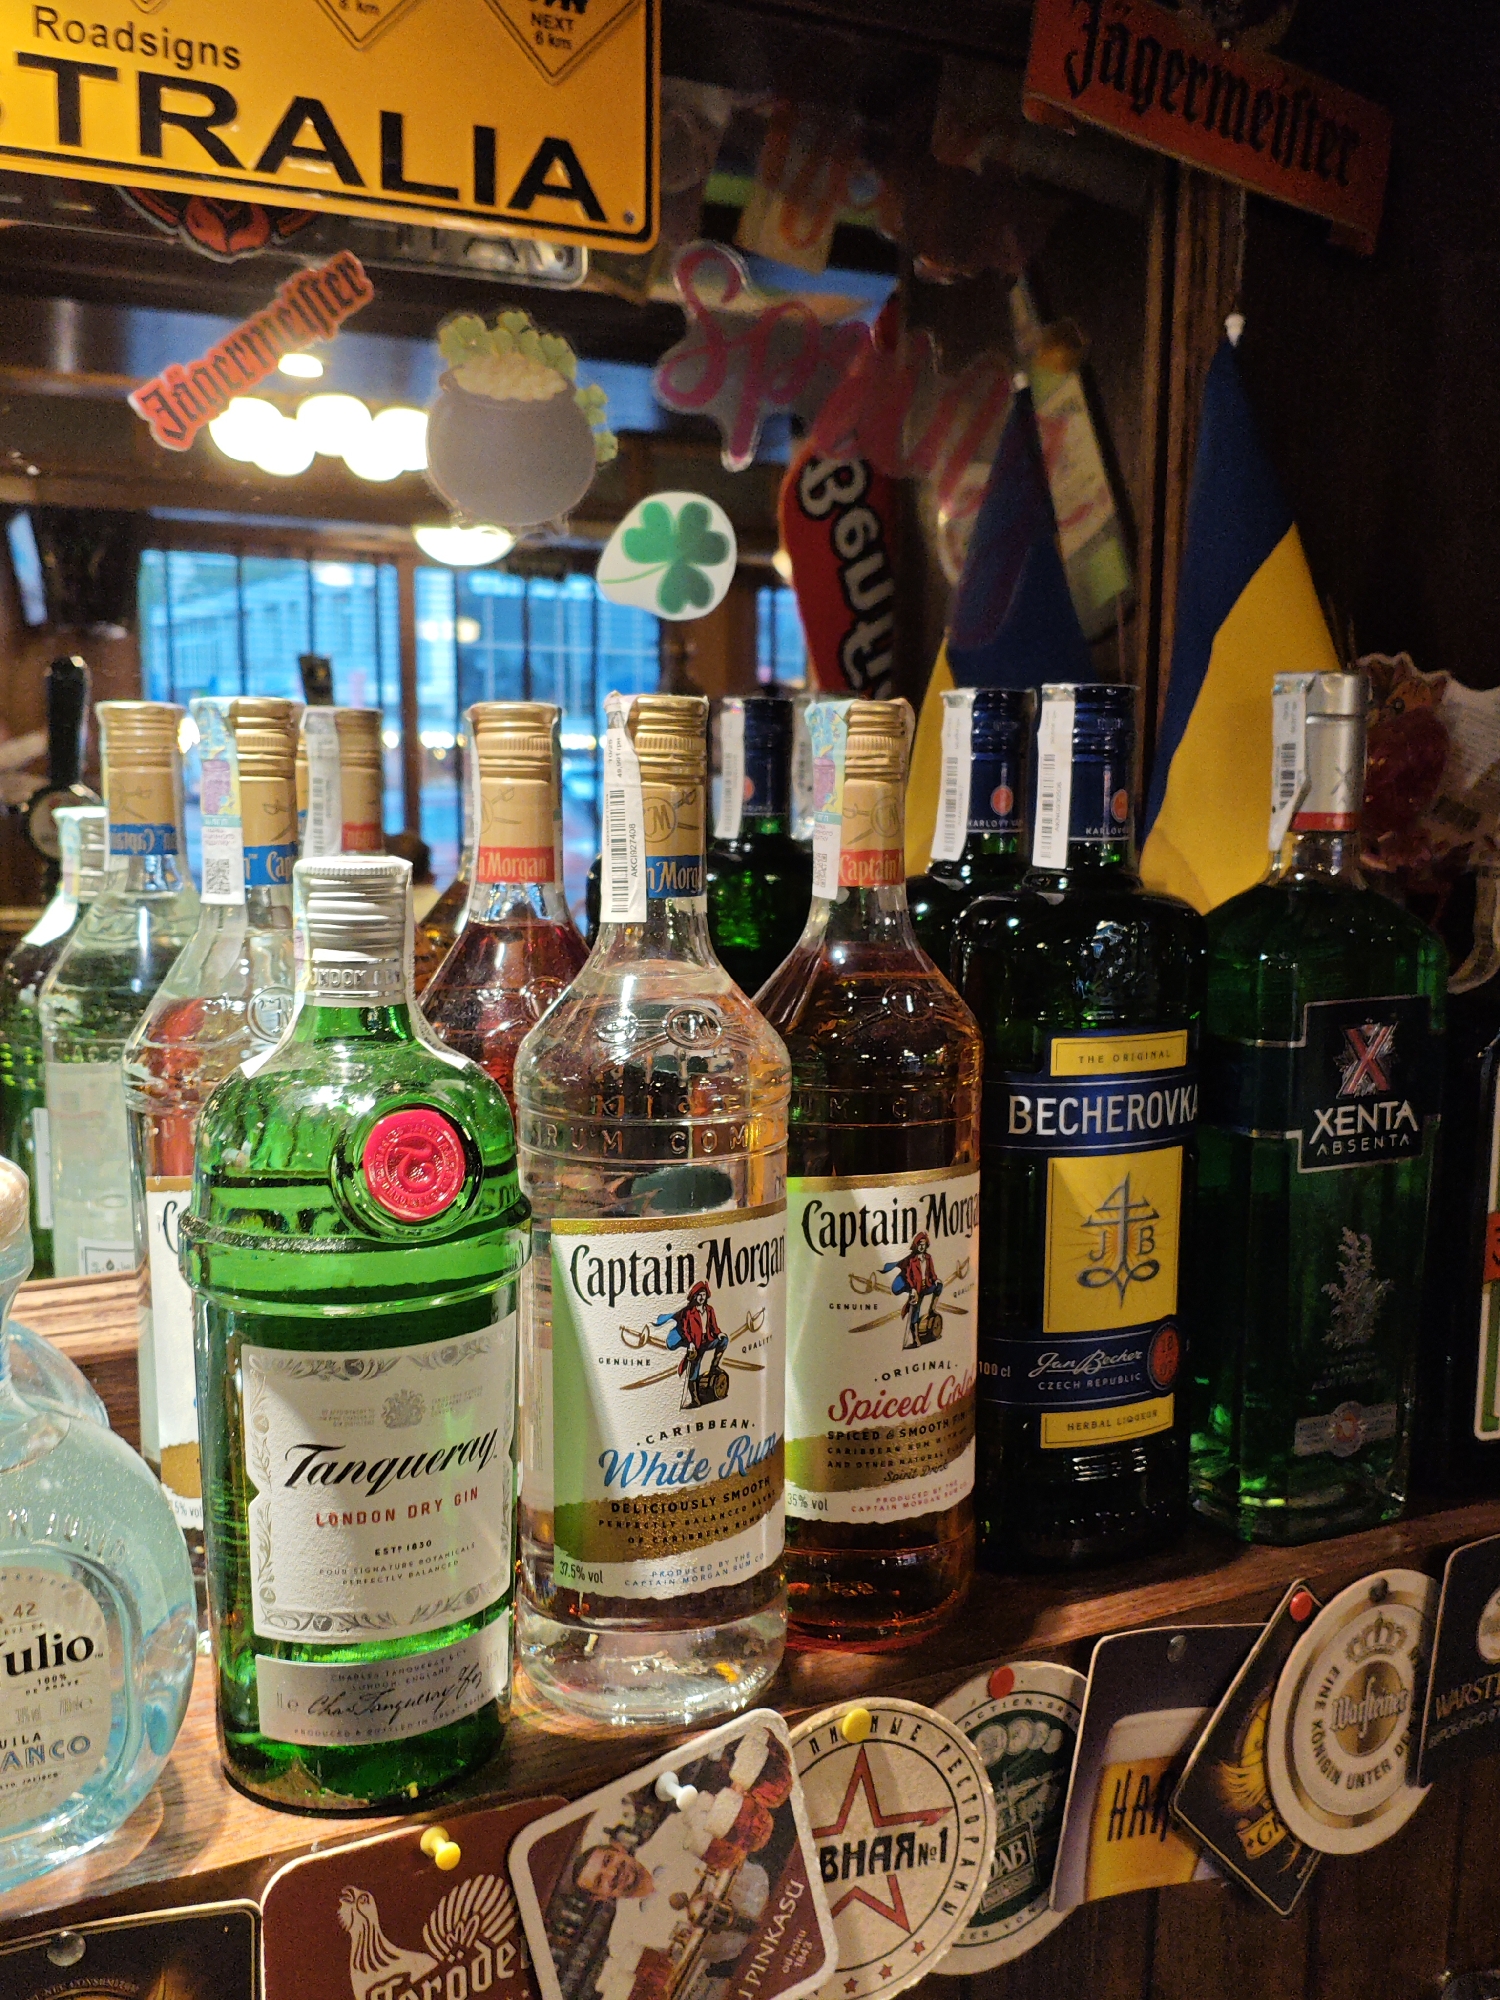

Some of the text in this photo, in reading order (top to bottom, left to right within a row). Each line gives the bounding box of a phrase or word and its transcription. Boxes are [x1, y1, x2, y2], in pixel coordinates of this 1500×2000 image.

[530, 13, 574, 31] NEXT
[33, 5, 241, 71] Roadsigns
[0, 50, 607, 222] TRALIA
[485, 853, 547, 883] Morgan
[839, 855, 897, 885] Captain
[1079, 1050, 1171, 1064] THE ORIGINAL
[1008, 1083, 1199, 1136] BECHEROVKA
[1309, 1100, 1419, 1144] XENTA
[1316, 1133, 1410, 1156] ABSENTA
[801, 1197, 918, 1258] Captain
[569, 1234, 785, 1307] Captain Morgan
[829, 1303, 879, 1311] GENUINE
[599, 1357, 651, 1367] GENUINE
[881, 1360, 952, 1382] ORIGINAL
[1000, 1366, 1011, 1378] cl
[1038, 1372, 1142, 1391] CZECH REPUBLIC
[828, 1382, 934, 1426] Spiced
[645, 1419, 750, 1444] CARIBBEAN
[828, 1430, 880, 1441] SPICED
[900, 1418, 949, 1438] SMOOTH
[1067, 1409, 1158, 1431] HERBAL LIQUEUR
[598, 1430, 777, 1488] White Rum
[827, 1446, 901, 1455] CARIBBEAN
[908, 1441, 930, 1451] RUM
[284, 1427, 498, 1498] Tanqueray
[827, 1460, 850, 1469] AND
[856, 1461, 894, 1469] OTHER
[315, 1486, 478, 1528] LONDON DRY GIN
[611, 1475, 772, 1514] DELICIOUSLY SMOOTH
[787, 1493, 828, 1512] 35% vol
[599, 1519, 677, 1530] PERFECTLY
[685, 1505, 747, 1526] BALANCED
[851, 1504, 898, 1513] CAPTAIN
[406, 1540, 432, 1551] 1830
[628, 1536, 644, 1544] OF
[653, 1526, 729, 1545] CARIBBEAN
[353, 1560, 414, 1575] SIGNATURE
[419, 1541, 476, 1566] BOTANICALS
[651, 1551, 750, 1579] PRODUCED BY THE
[342, 1560, 459, 1586] PERFECTLY BALANCED
[588, 1569, 604, 1584] vol
[624, 1578, 676, 1587] CAPTAIN
[682, 1569, 729, 1584] MORGAN
[733, 1560, 751, 1572] RUM
[0, 1633, 94, 1677] ulio
[808, 1714, 924, 1755] ПИНЫЕ
[1346, 1757, 1392, 1790] UNTER
